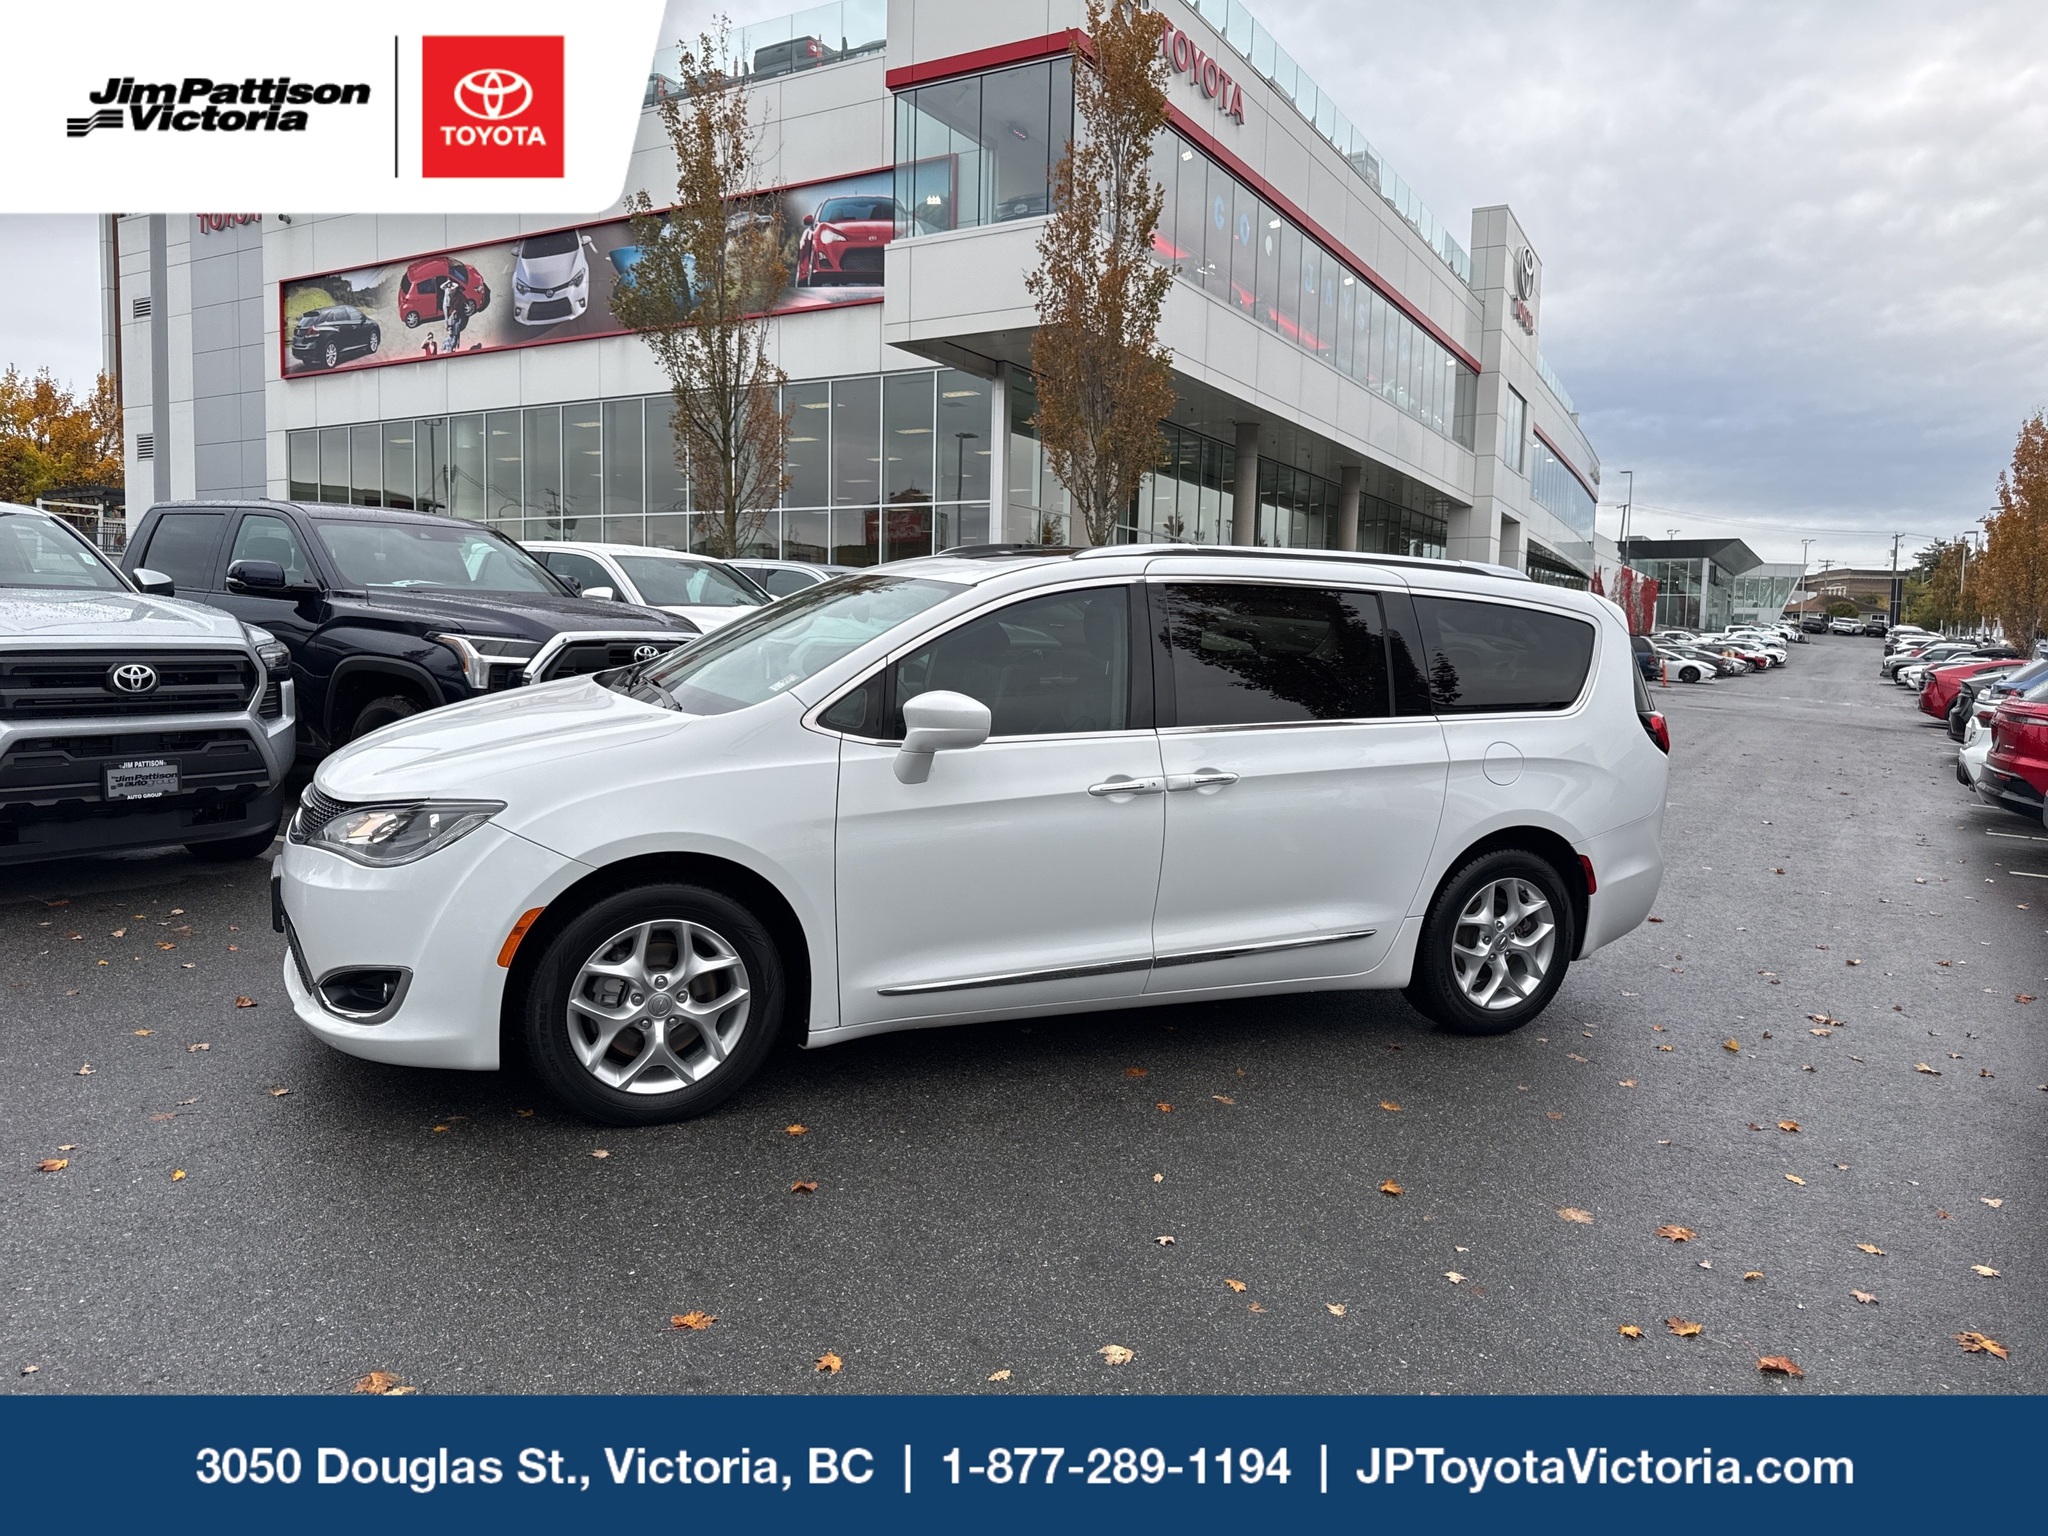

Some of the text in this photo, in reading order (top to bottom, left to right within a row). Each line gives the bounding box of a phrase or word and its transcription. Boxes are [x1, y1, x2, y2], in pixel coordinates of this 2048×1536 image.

[1162, 20, 1245, 125] TOYOTA
[122, 760, 164, 769] JIM PATTISON
